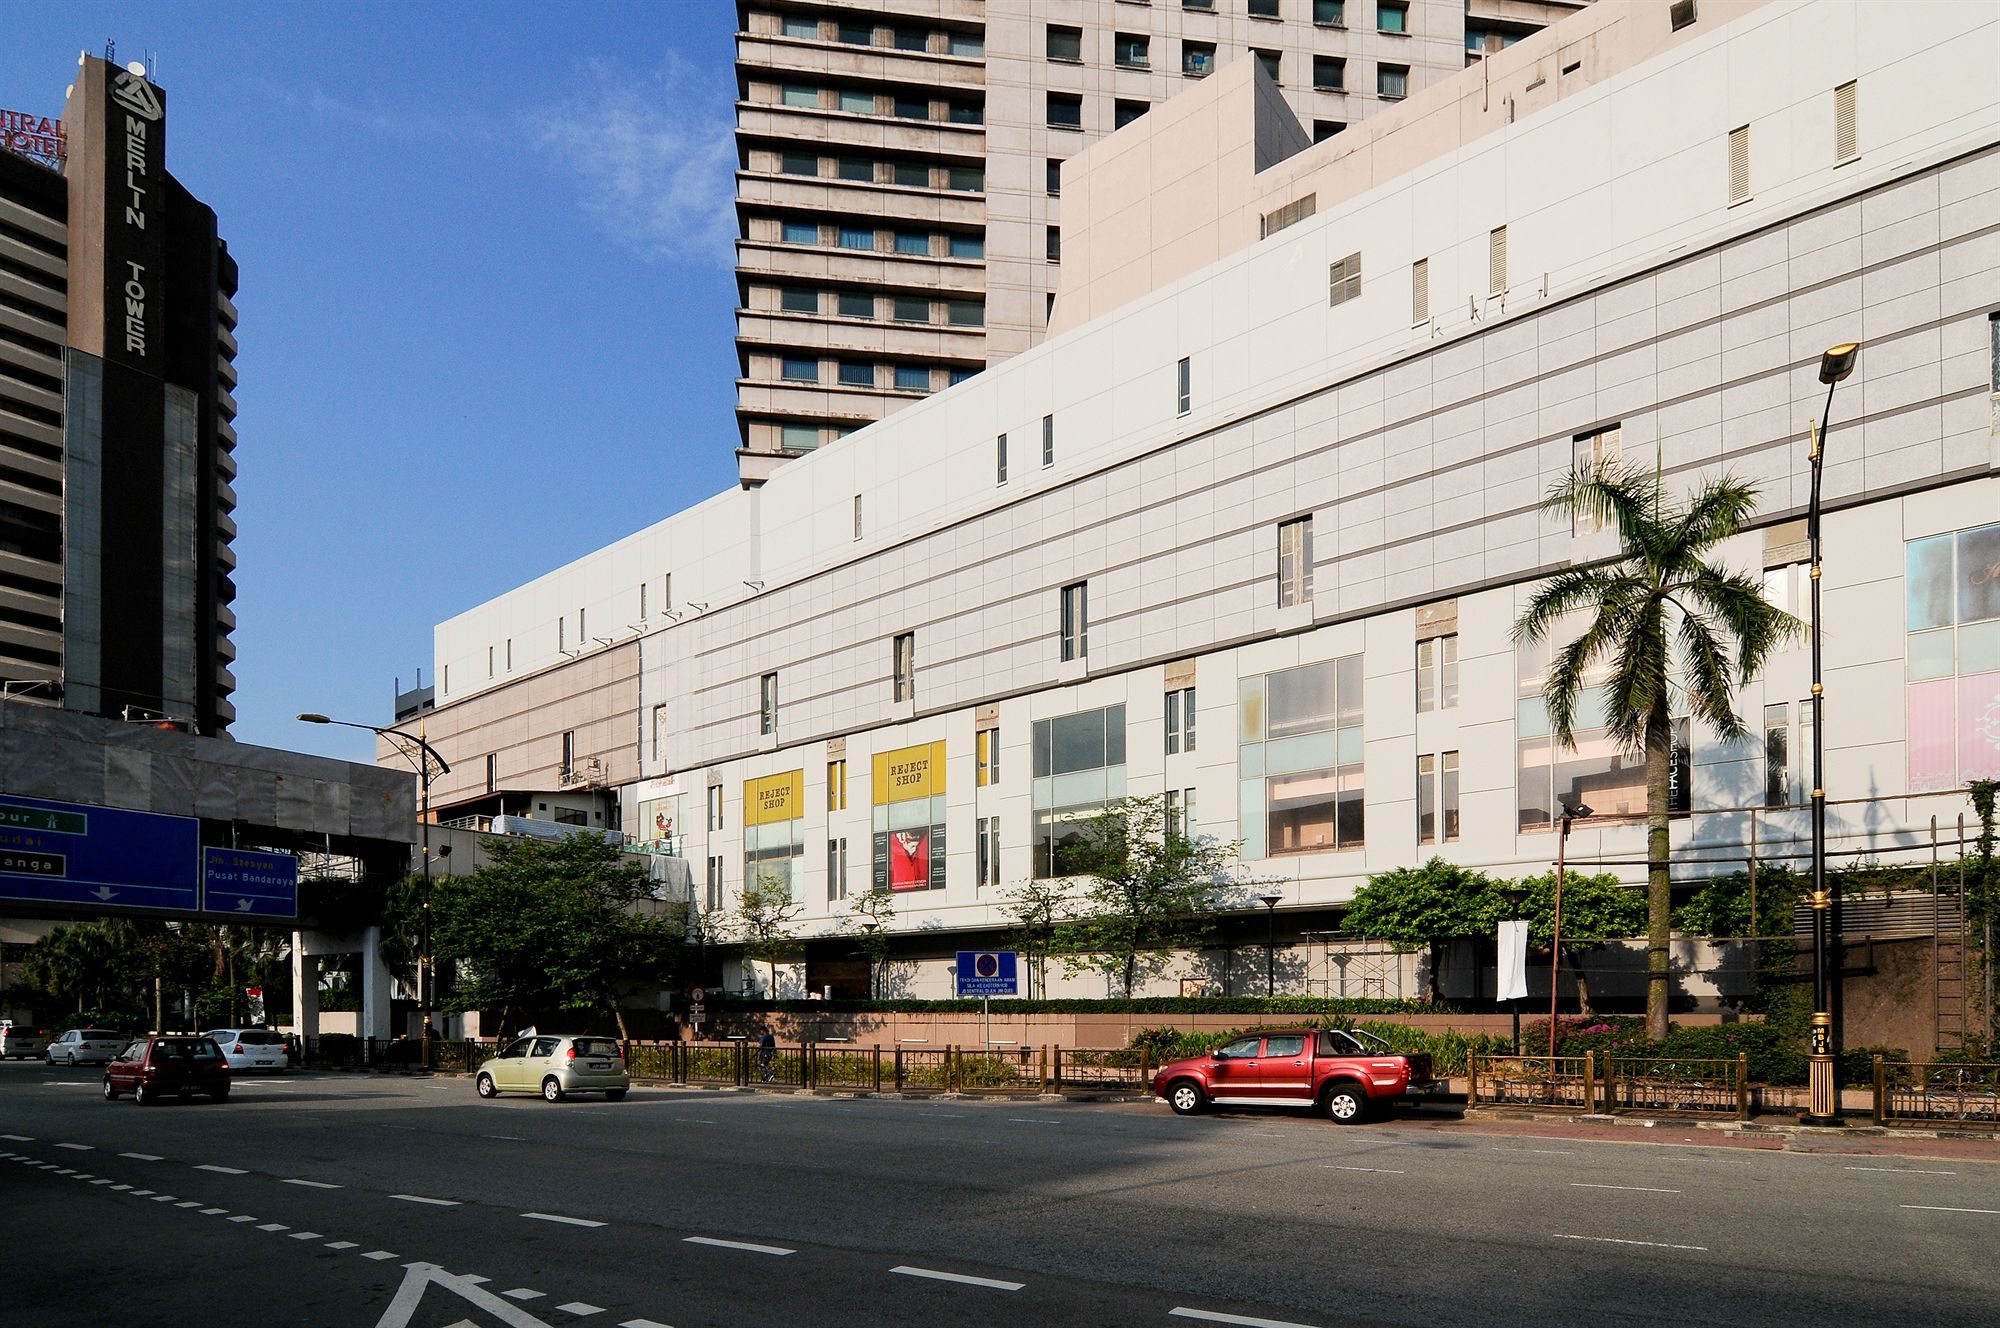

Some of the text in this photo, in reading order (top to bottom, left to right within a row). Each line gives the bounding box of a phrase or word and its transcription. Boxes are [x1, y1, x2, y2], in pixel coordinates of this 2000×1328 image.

[125, 115, 146, 357] MERLIN TOWER
[890, 760, 929, 776] REJECT
[896, 773, 922, 787] SHOP
[759, 786, 791, 801] REJECT
[763, 798, 786, 810] SHOP
[4, 858, 52, 871] anga
[207, 869, 294, 887] Pusat Bandaraya
